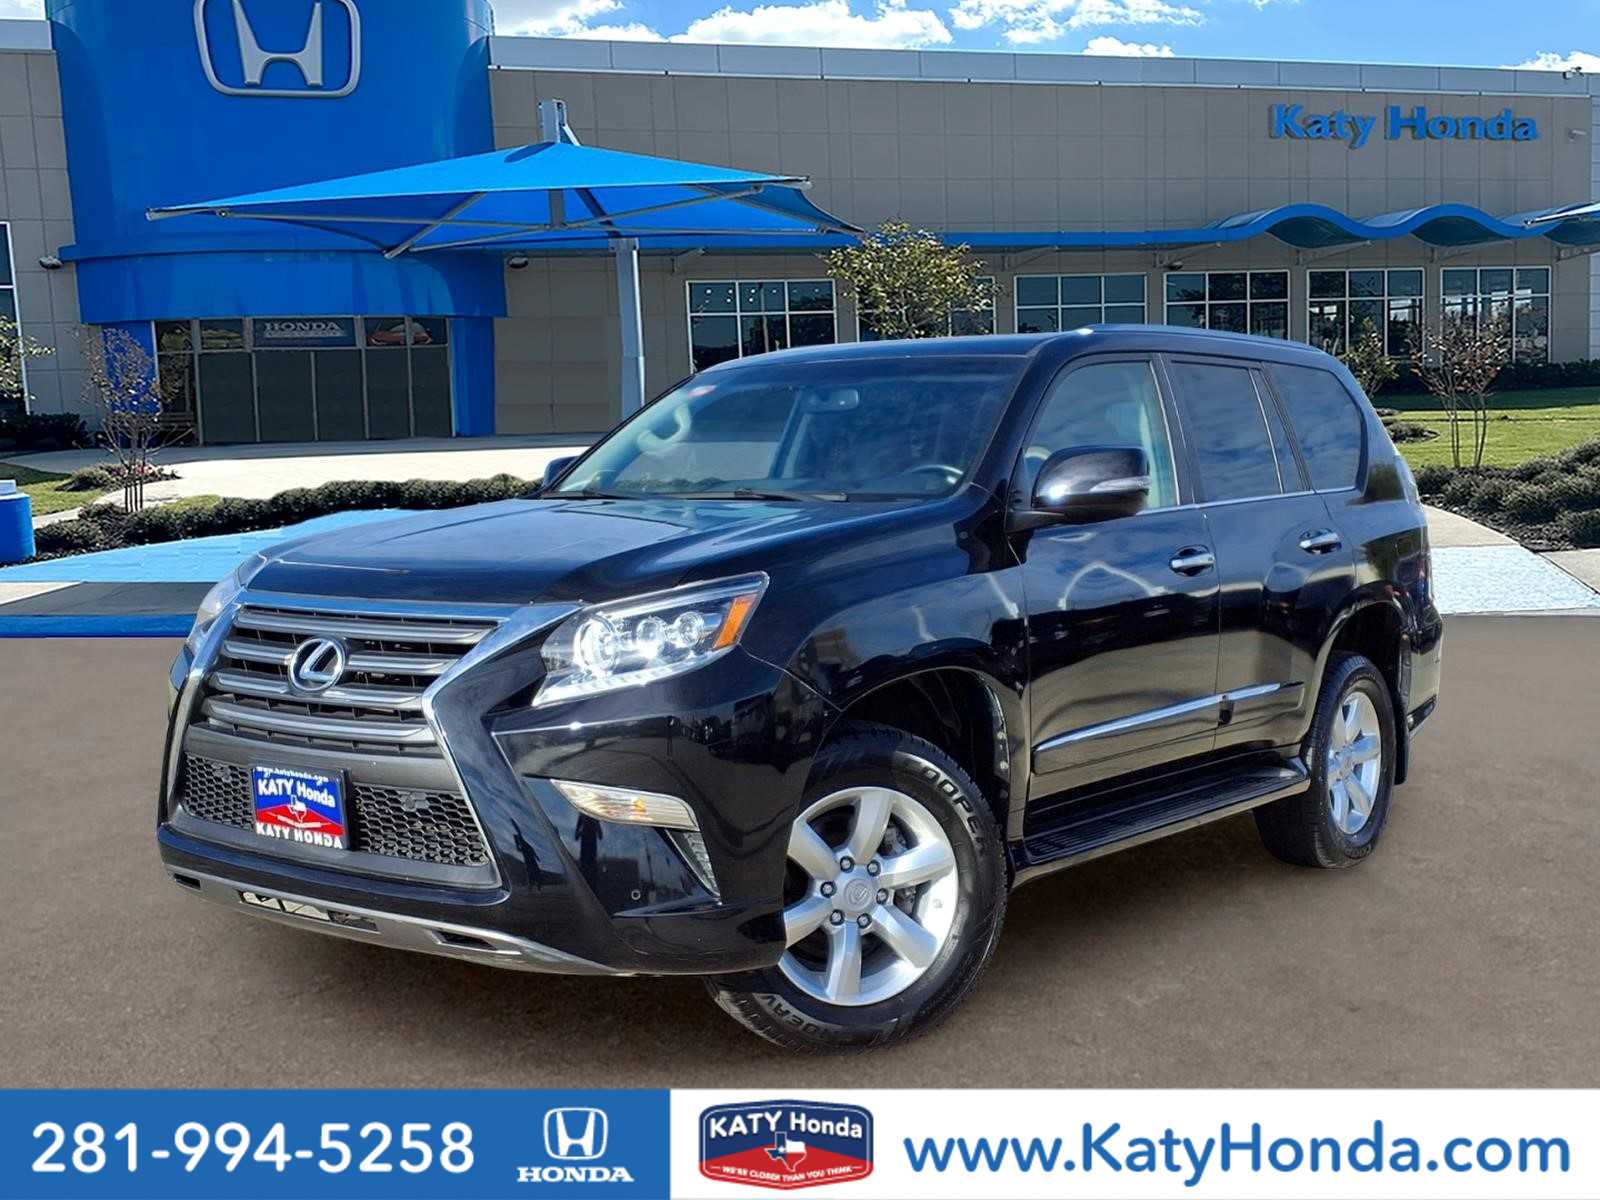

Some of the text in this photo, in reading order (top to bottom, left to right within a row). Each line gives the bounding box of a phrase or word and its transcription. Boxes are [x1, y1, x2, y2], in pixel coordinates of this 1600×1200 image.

[1269, 103, 1540, 150] Katy Honda
[264, 321, 341, 332] HONDA
[257, 779, 336, 808] KATY Honda
[256, 822, 343, 850] KATY HONDA
